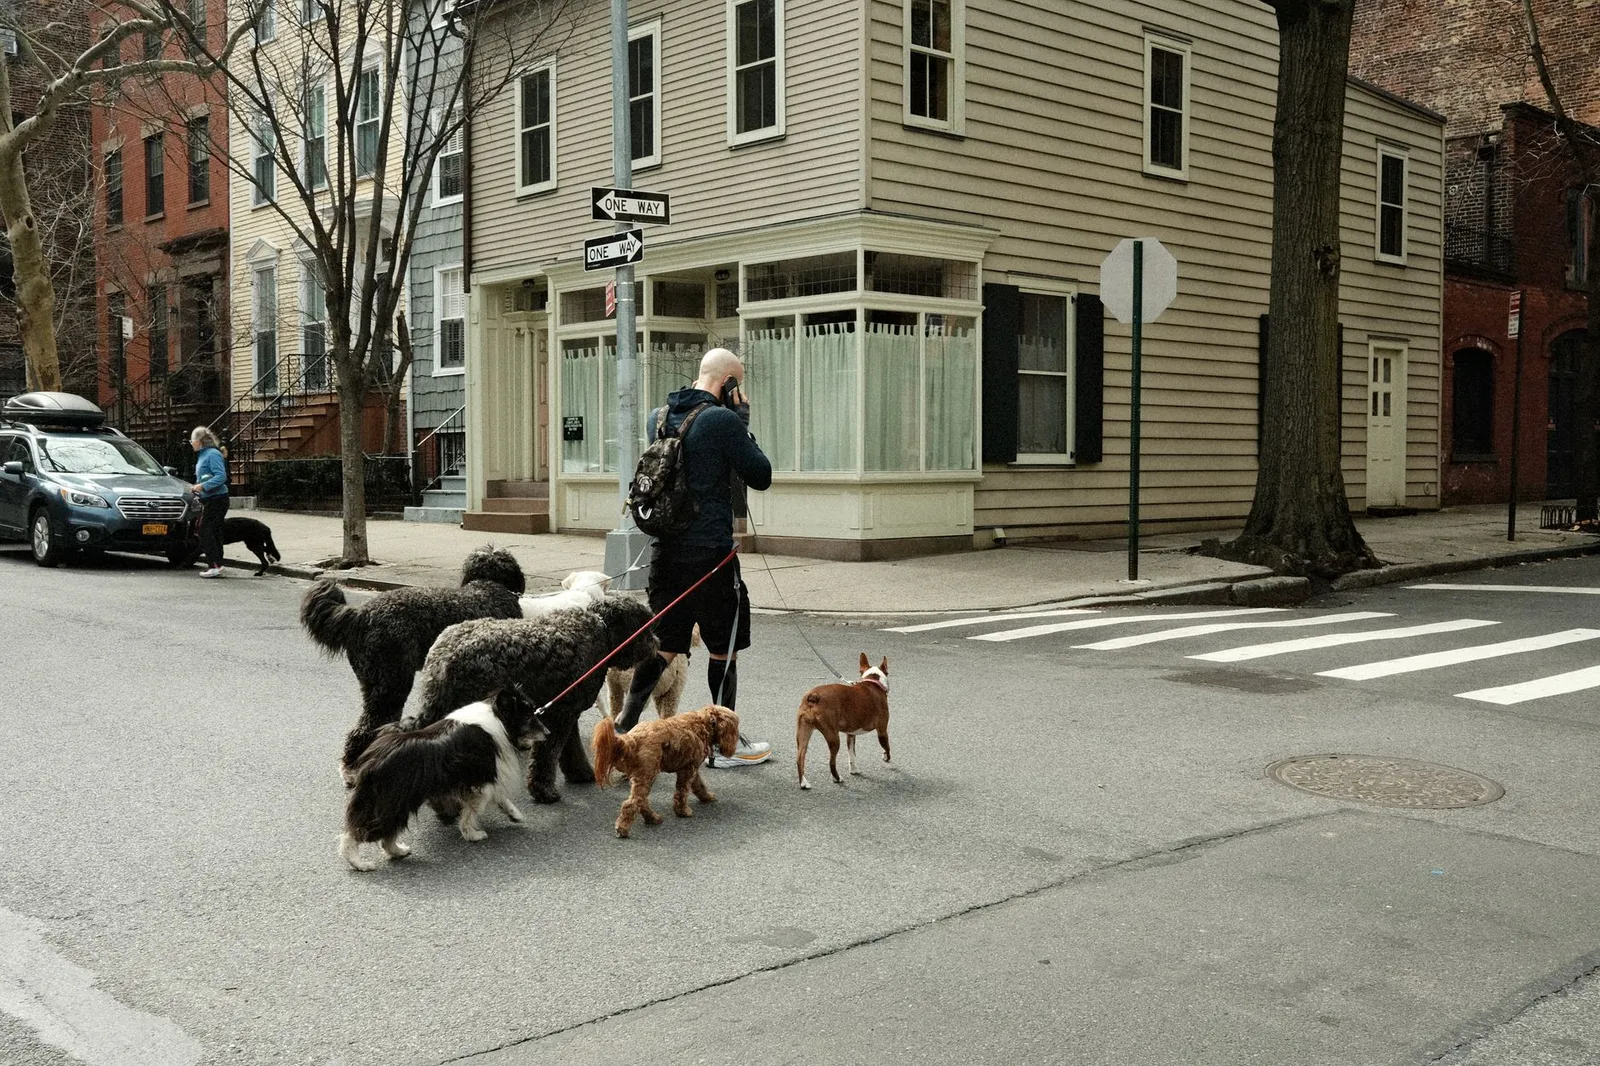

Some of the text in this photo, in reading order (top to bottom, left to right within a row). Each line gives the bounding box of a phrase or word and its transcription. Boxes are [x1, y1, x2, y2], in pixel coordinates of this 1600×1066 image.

[605, 198, 660, 215] ONE WAY
[589, 240, 637, 261] ONE WAY
